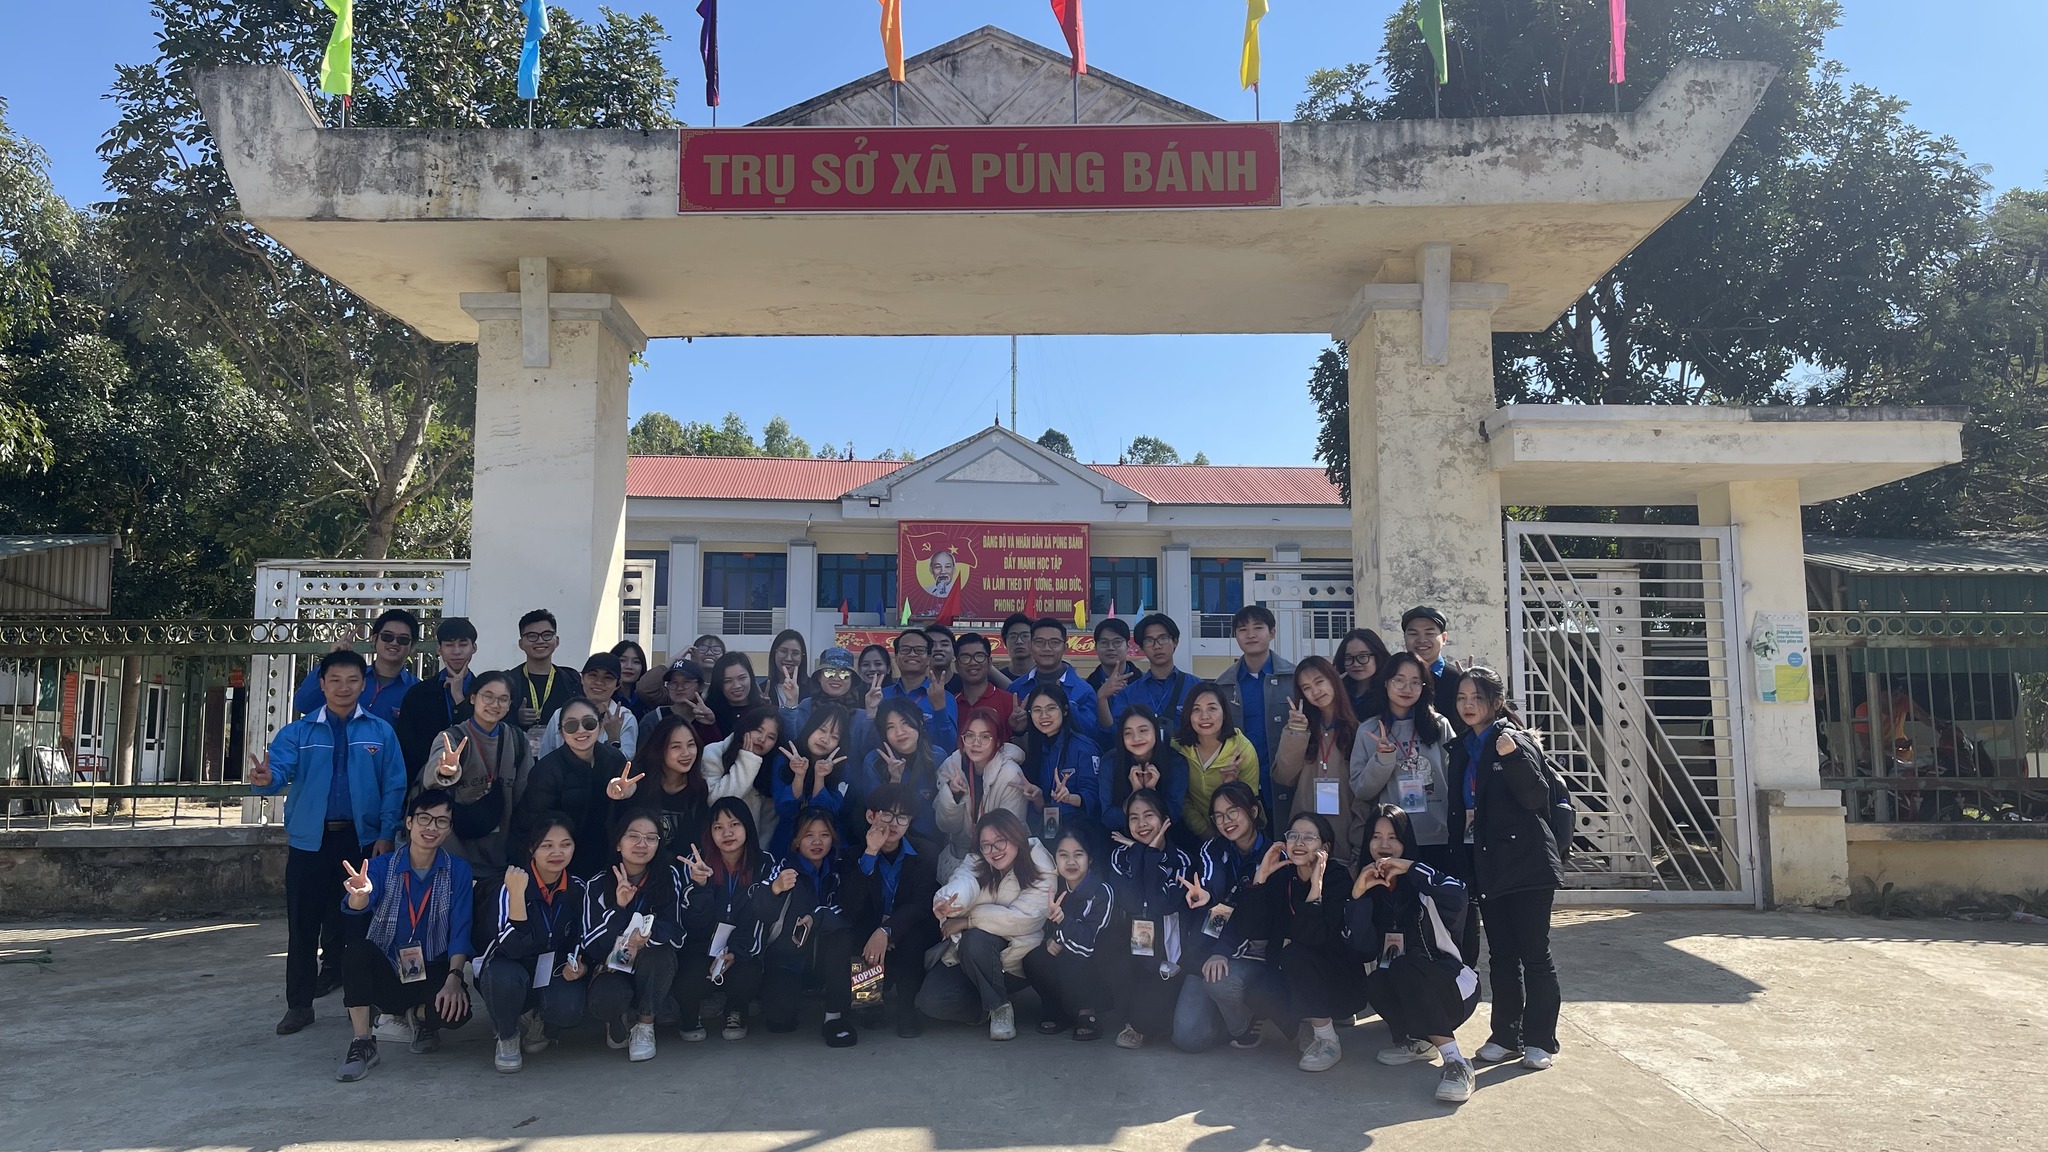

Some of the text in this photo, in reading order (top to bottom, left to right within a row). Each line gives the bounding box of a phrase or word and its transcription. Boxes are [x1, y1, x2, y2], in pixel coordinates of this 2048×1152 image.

[702, 136, 1257, 204] TRỤ SỞ XÃ PÚNG BÁNH
[1007, 533, 1015, 549] VÀ
[1015, 533, 1031, 549] NHÂN
[1031, 533, 1044, 549] DÂN
[1044, 534, 1052, 549] XÃ
[1052, 533, 1067, 549] PÚNG
[1068, 533, 1083, 549] BÁNH
[1017, 556, 1036, 573] MẠNH
[1036, 556, 1050, 573] HỌC
[1050, 554, 1063, 573] TẬP
[982, 574, 991, 591] VÀ
[992, 574, 1005, 591] LÀM
[1006, 577, 1023, 591] THEO
[993, 598, 1015, 612] PHONG
[1016, 596, 1027, 612] CÁ
[1055, 599, 1072, 612] MINH
[852, 965, 883, 985] KOPIKO
